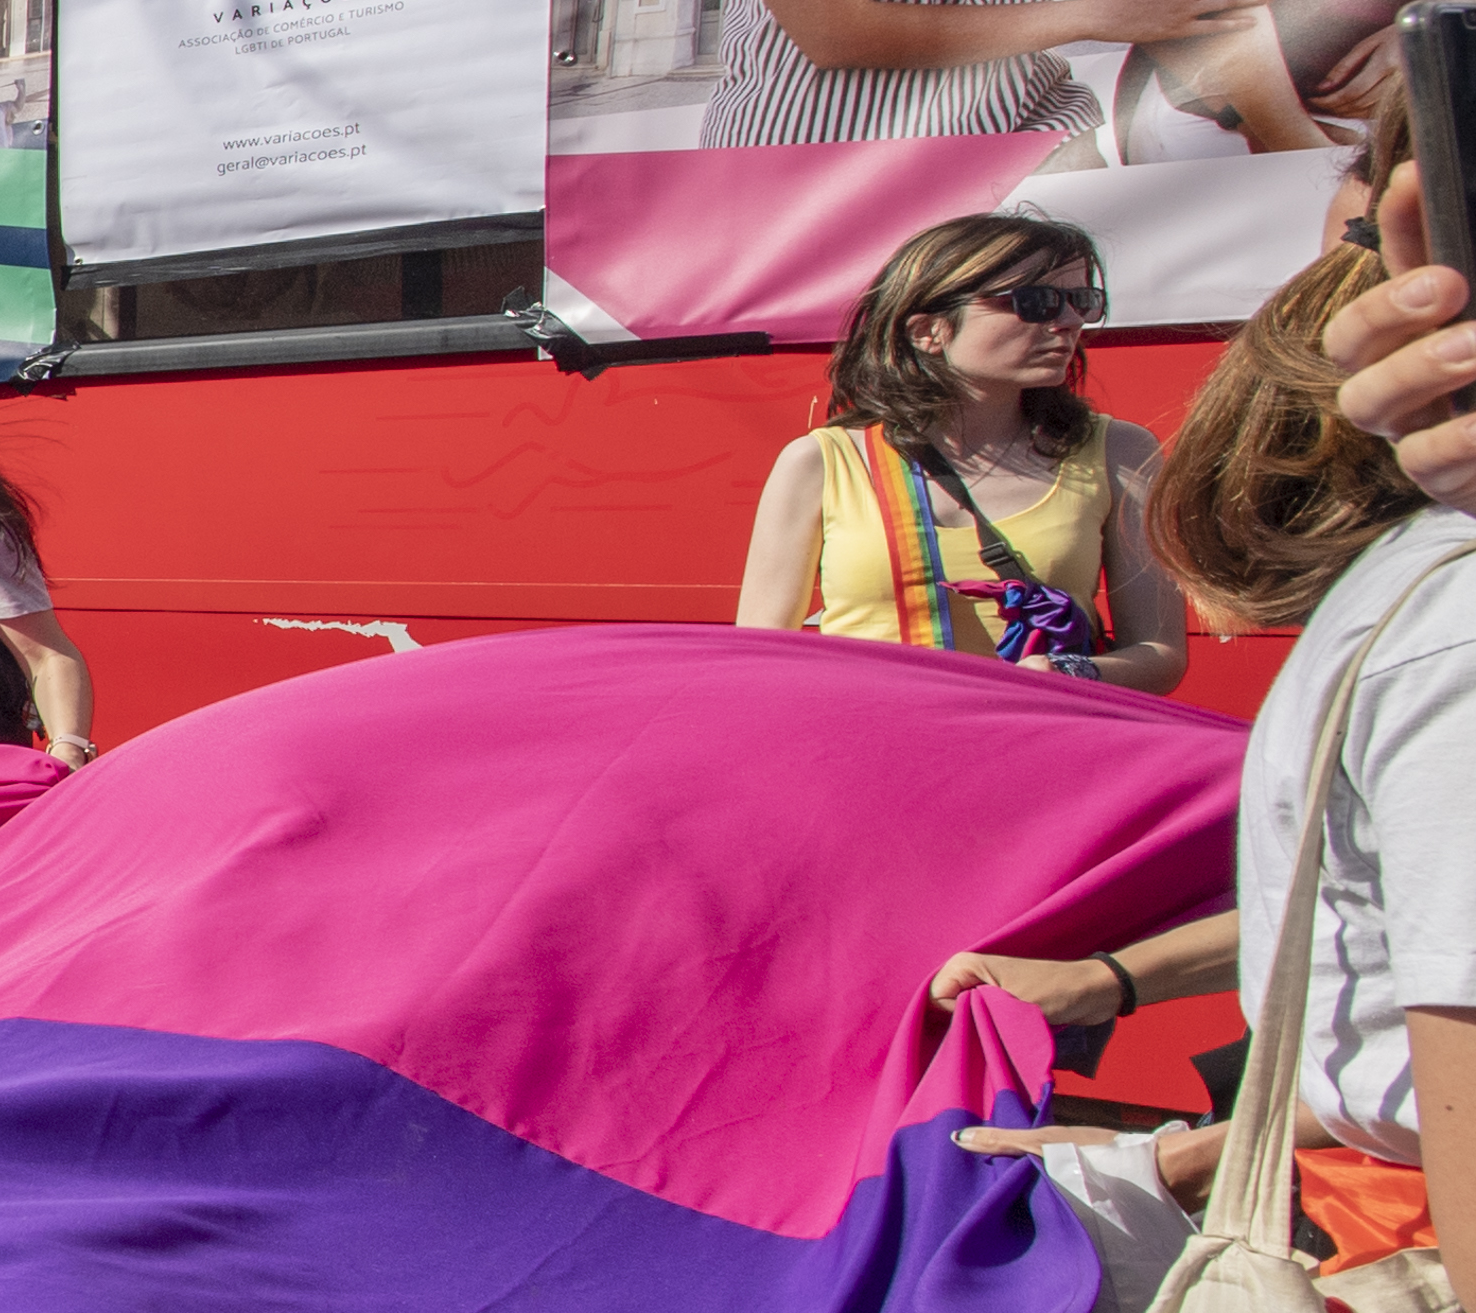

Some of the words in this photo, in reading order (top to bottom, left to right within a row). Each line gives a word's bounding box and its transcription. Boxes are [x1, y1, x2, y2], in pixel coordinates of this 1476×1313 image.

[178, 28, 253, 49] ASSOCIAÇÃO
[273, 13, 334, 34] COMÉRCIO
[348, 0, 405, 20] TURISMO
[235, 41, 267, 55] LGBTI
[287, 27, 351, 45] PORTUGAL
[223, 122, 360, 151] www.variacoes.pt
[217, 144, 367, 176] geral@variacoes.pt
